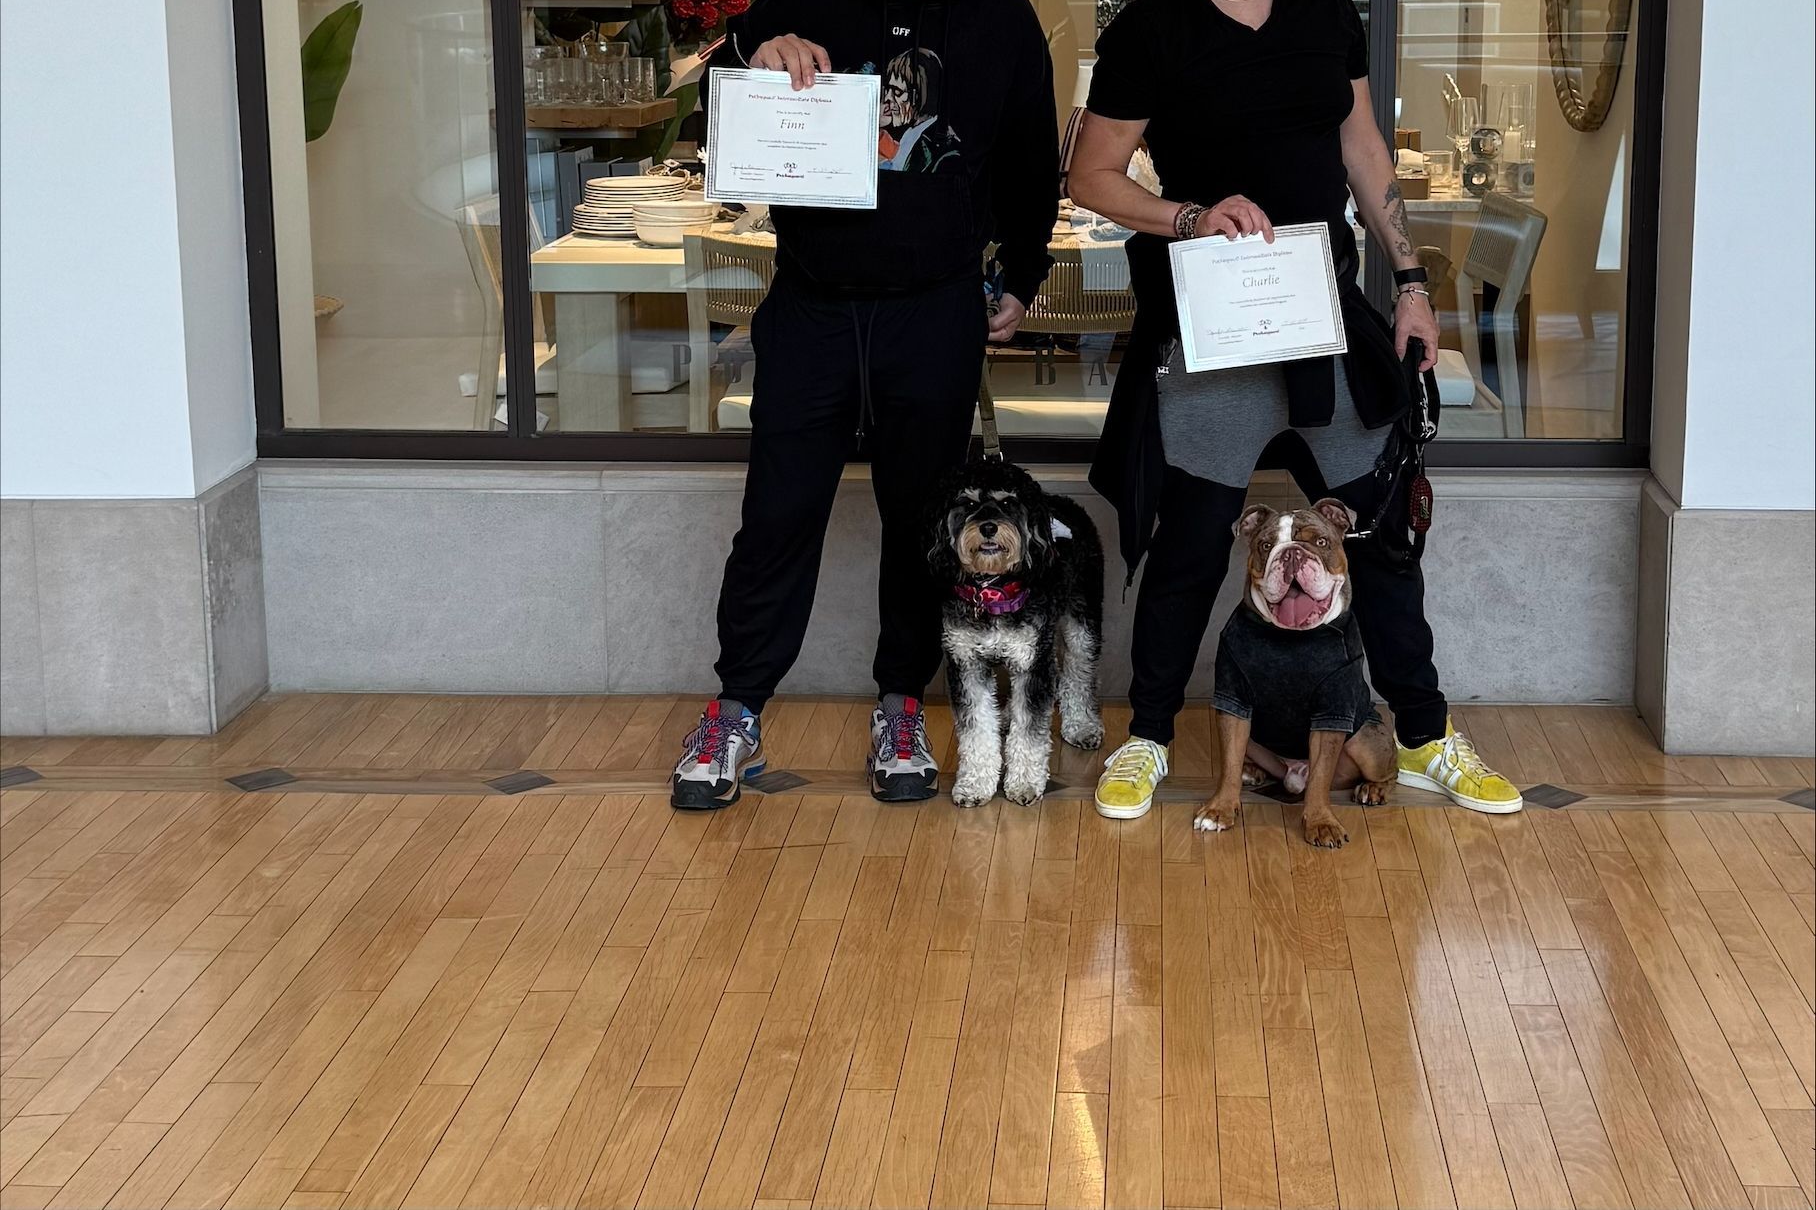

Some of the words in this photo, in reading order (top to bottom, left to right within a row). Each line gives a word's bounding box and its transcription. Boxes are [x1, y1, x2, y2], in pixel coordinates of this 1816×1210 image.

[892, 26, 911, 37] OFF
[780, 118, 806, 130] Finn
[1242, 274, 1281, 288] Charlie
